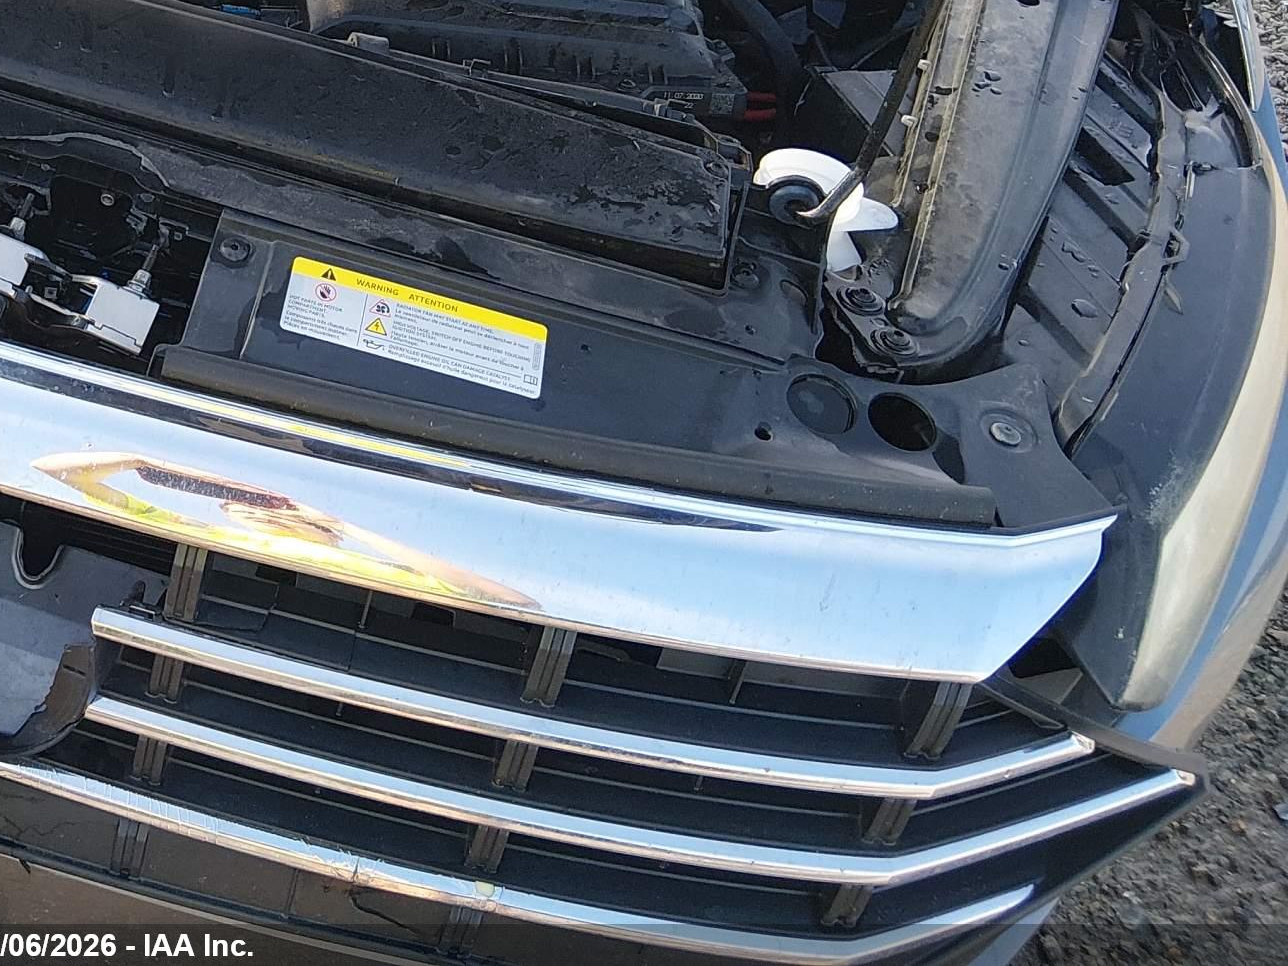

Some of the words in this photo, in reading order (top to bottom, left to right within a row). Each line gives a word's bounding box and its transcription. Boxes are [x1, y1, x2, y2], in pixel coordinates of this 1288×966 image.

[664, 92, 704, 100] 11.07.2020
[356, 279, 399, 296] WARNING
[409, 294, 458, 312] ATTENTION
[463, 365, 485, 375] DAMAGE
